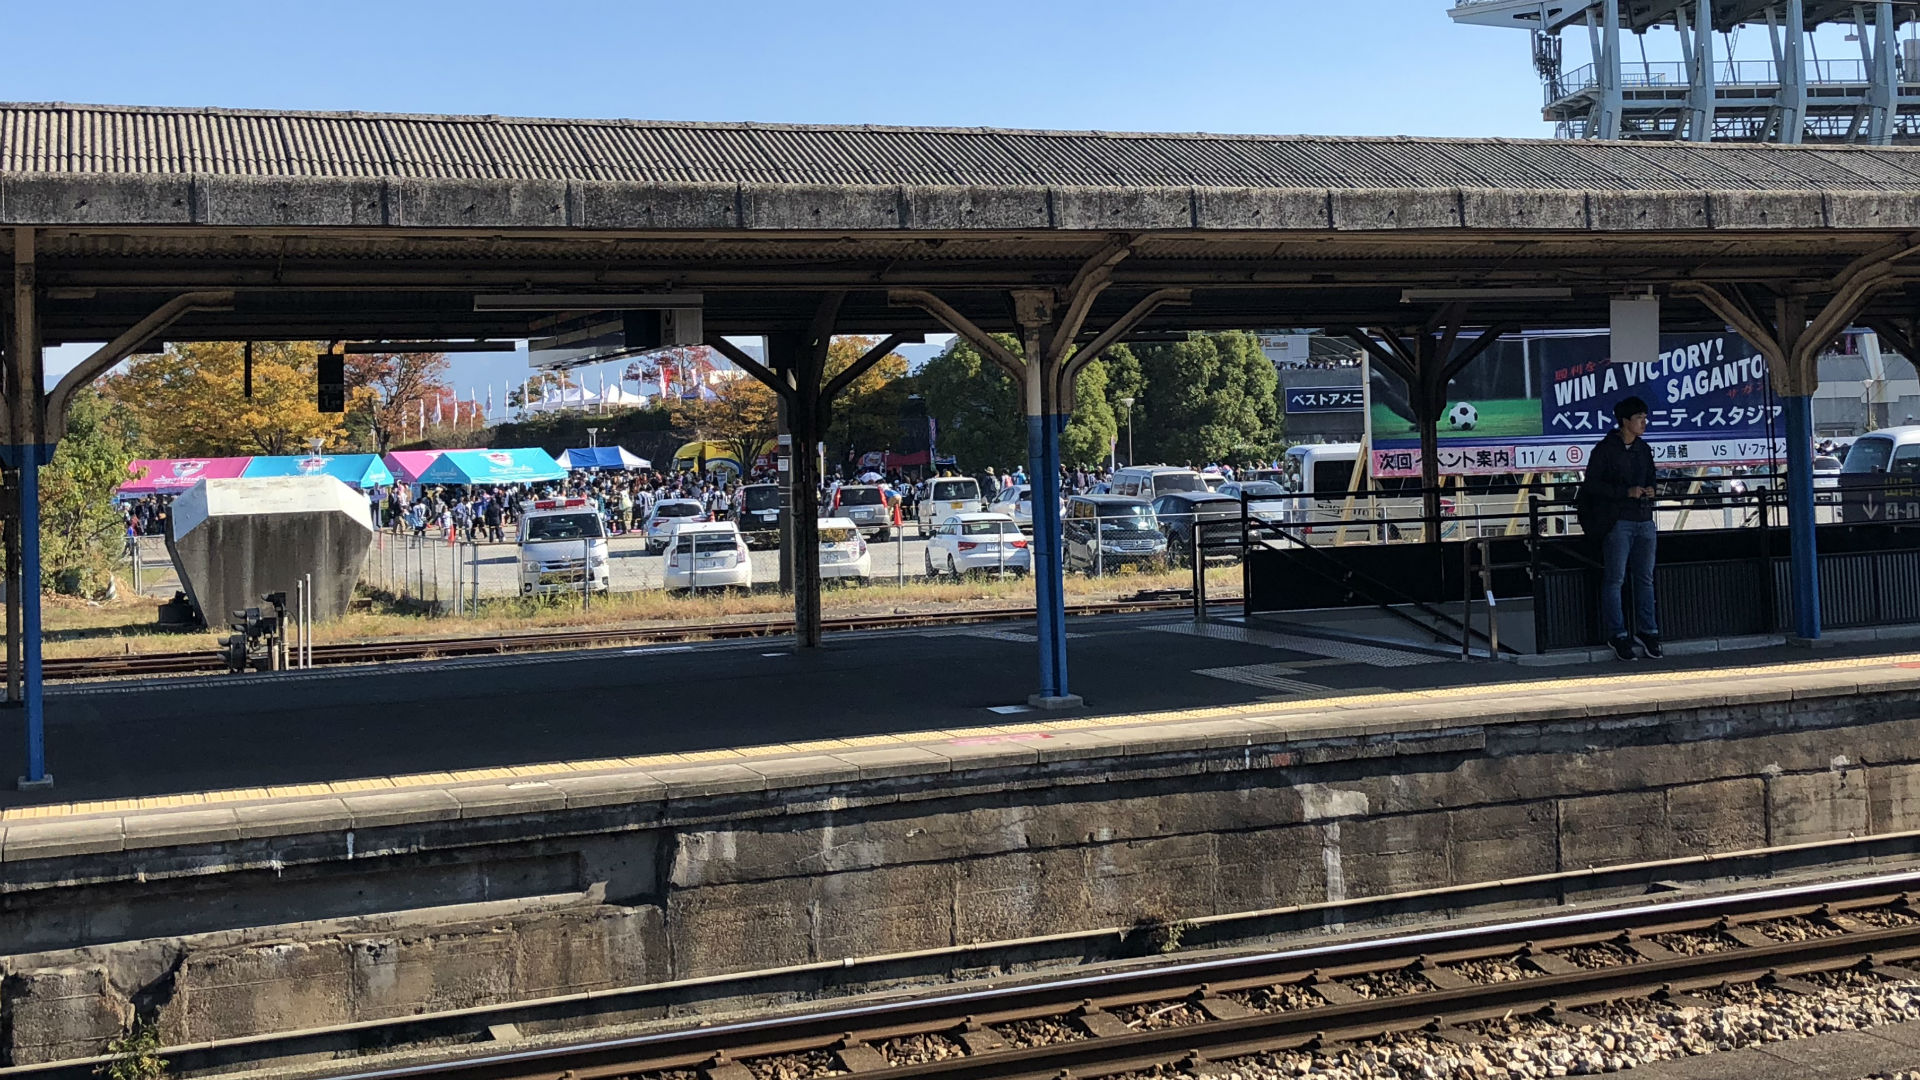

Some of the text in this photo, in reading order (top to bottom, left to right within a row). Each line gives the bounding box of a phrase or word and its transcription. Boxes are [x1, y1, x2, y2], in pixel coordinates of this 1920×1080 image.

[1554, 338, 1724, 406] WIN A VICTORY!
[1667, 354, 1769, 403] SAGANTO
[1552, 404, 1782, 432] ベストニティスタジア
[1379, 450, 1509, 470] 次回ント案内
[1712, 444, 1727, 456] VS
